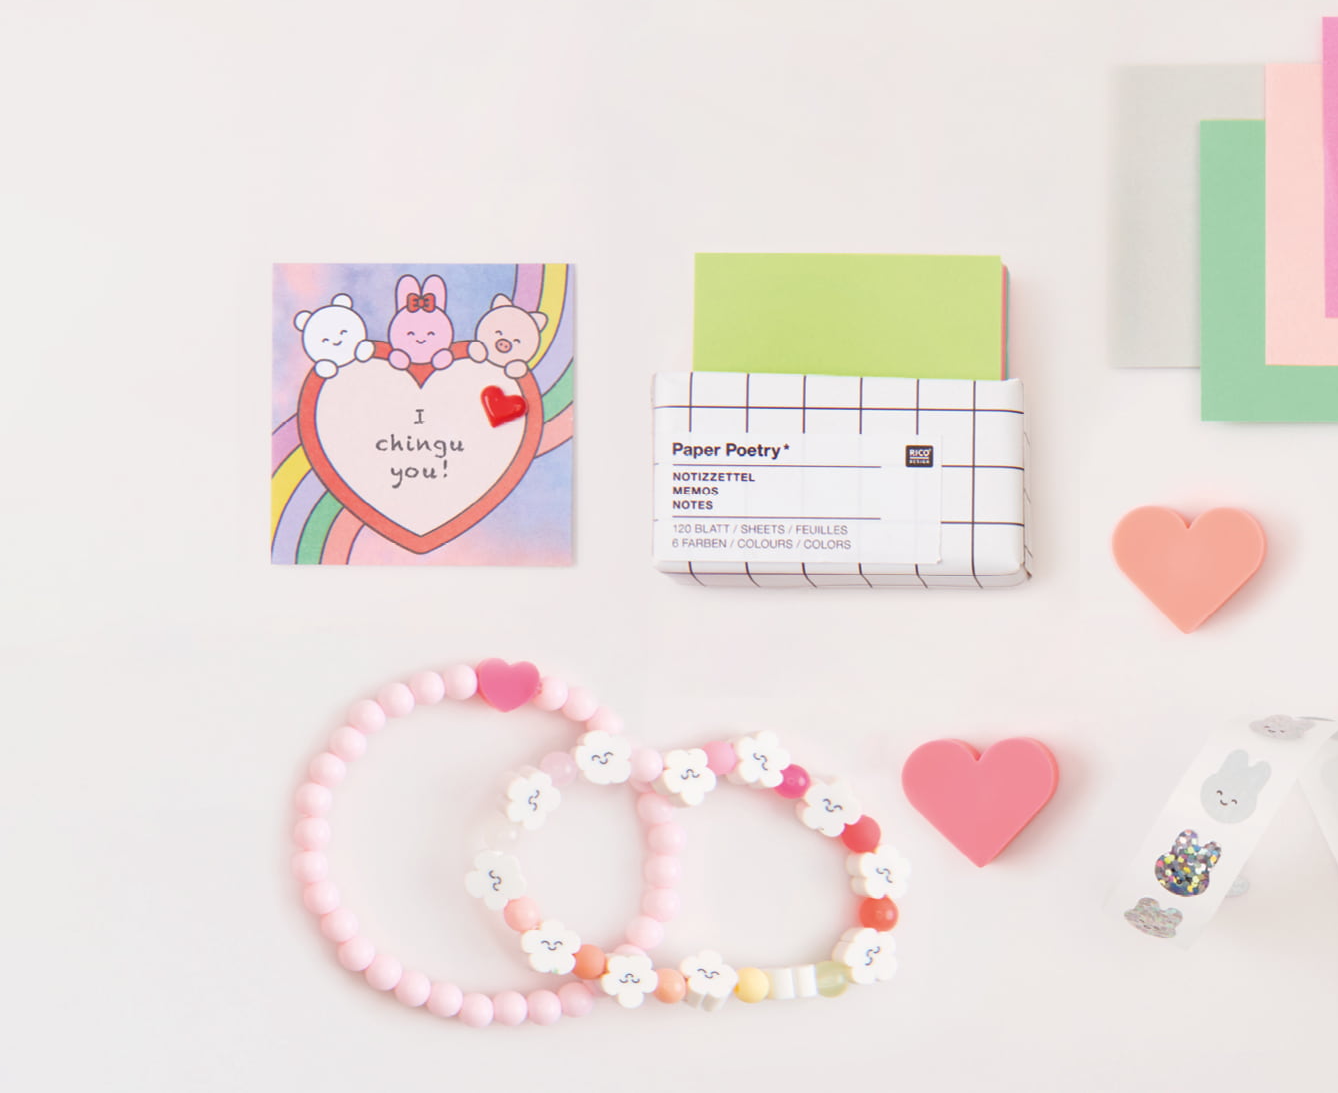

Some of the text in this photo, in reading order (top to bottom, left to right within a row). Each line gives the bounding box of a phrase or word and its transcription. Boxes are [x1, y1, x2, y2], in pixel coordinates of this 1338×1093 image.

[413, 409, 425, 425] I
[375, 434, 465, 458] chingu
[672, 442, 721, 459] Paper
[390, 460, 448, 489] you!
[673, 472, 756, 482] NOTIZZETTEL
[673, 486, 719, 496] MEMOS
[673, 500, 714, 510] NOTES
[673, 524, 691, 534] 120
[695, 524, 730, 534] BLATT
[740, 524, 786, 535] SHEETS
[796, 525, 848, 535] FEUILLES
[672, 538, 679, 548] 6
[682, 538, 727, 548] FARBEN
[737, 539, 793, 549] COLOURS
[803, 539, 852, 550] COLORS
